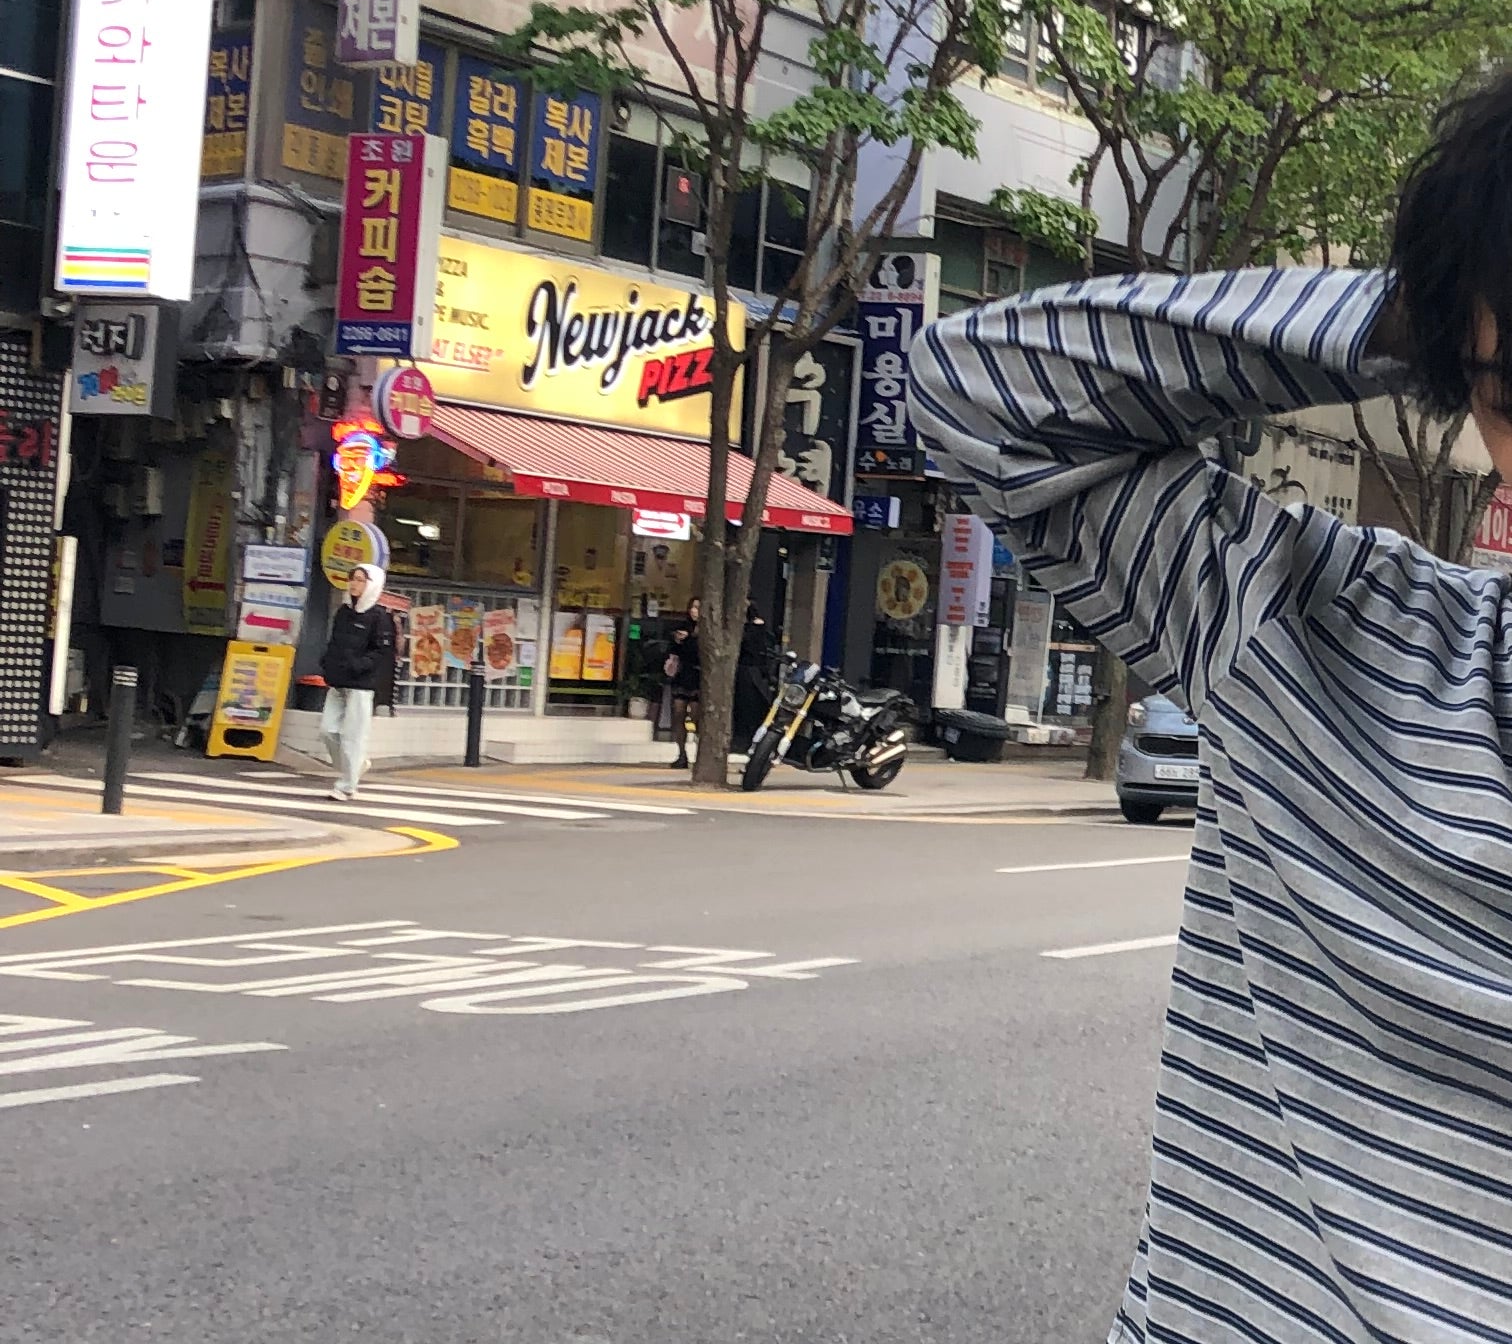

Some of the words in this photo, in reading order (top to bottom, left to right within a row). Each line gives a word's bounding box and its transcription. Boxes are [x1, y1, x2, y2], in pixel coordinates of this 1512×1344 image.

[540, 137, 590, 183] 제본
[545, 97, 593, 146] 복사
[521, 277, 712, 393] Newjack
[861, 307, 914, 445] 미용실
